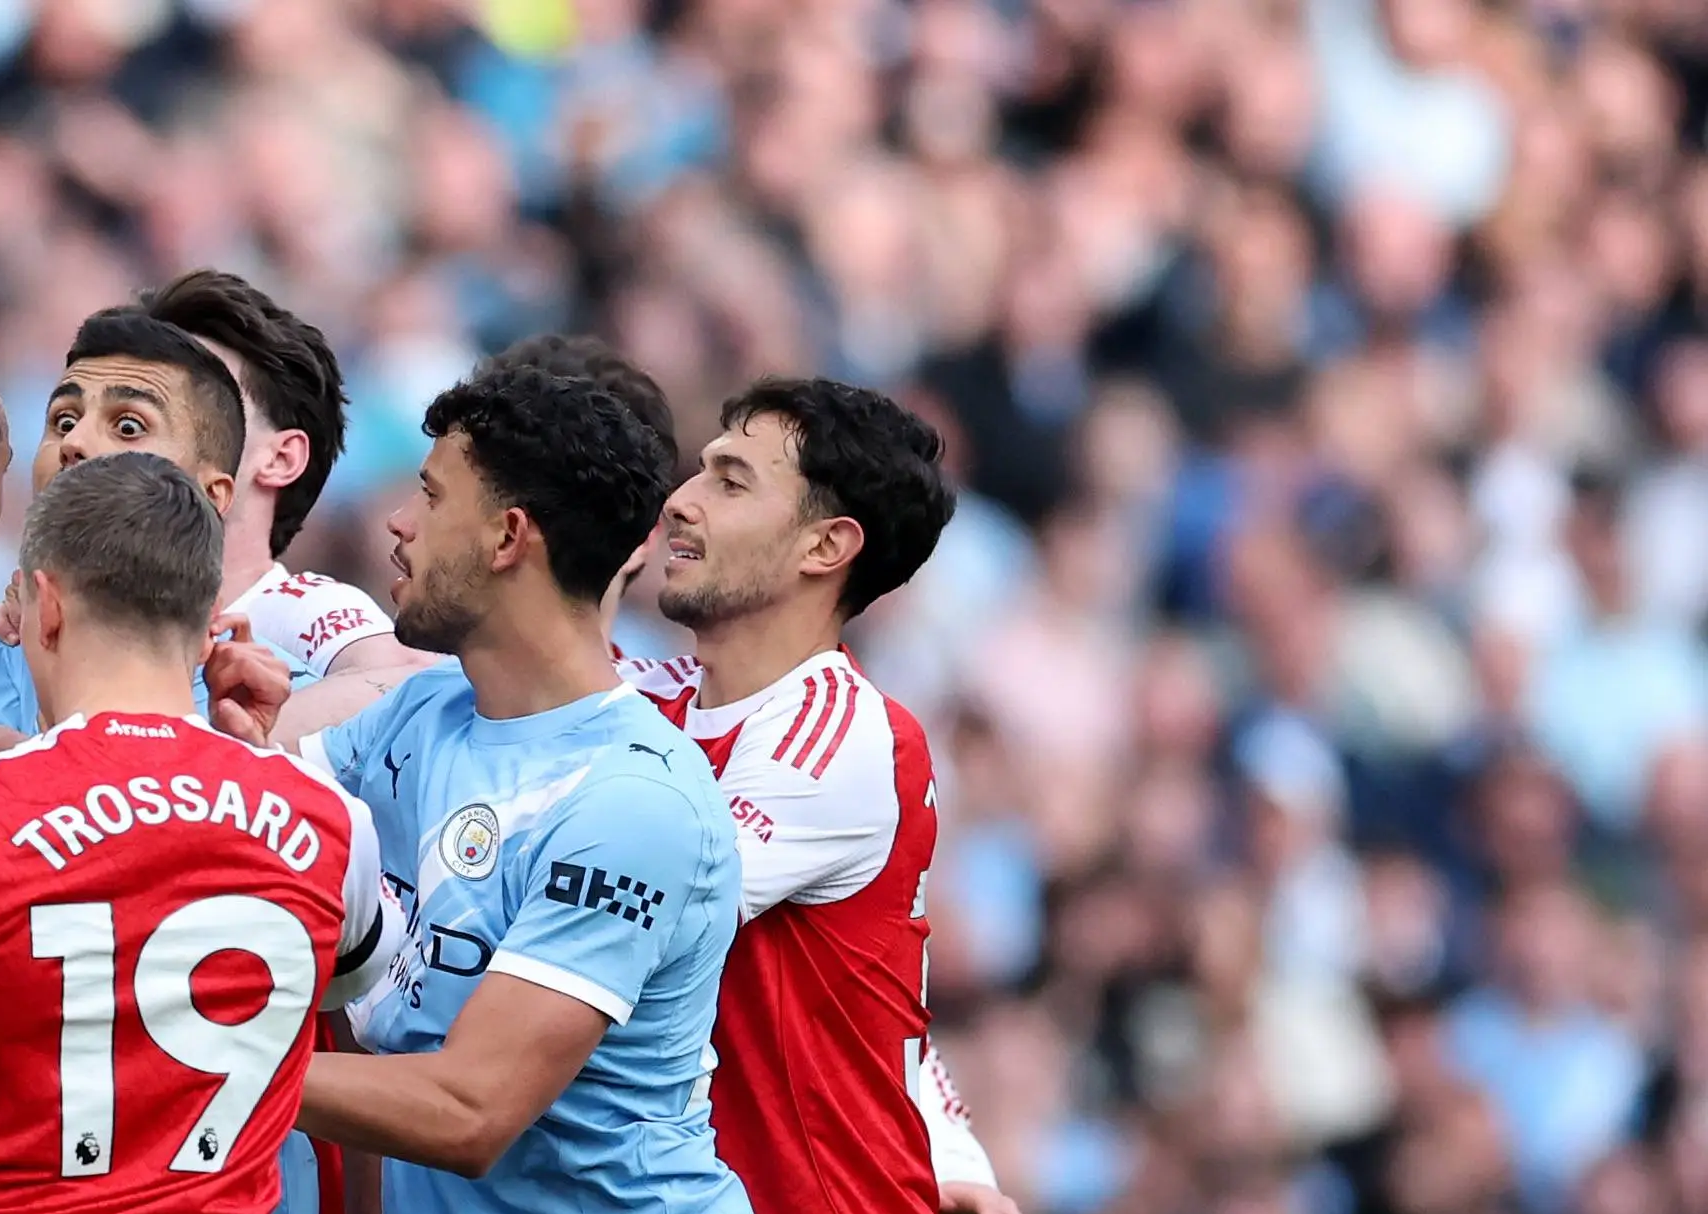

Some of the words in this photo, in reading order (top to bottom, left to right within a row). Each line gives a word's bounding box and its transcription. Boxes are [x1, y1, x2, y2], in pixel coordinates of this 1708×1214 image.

[298, 608, 364, 643] VISIT
[104, 718, 177, 738] Arsenal
[11, 774, 321, 872] TROSSARD
[728, 795, 775, 829] ISIT
[452, 860, 473, 875] CITY
[28, 893, 317, 1178] 19
